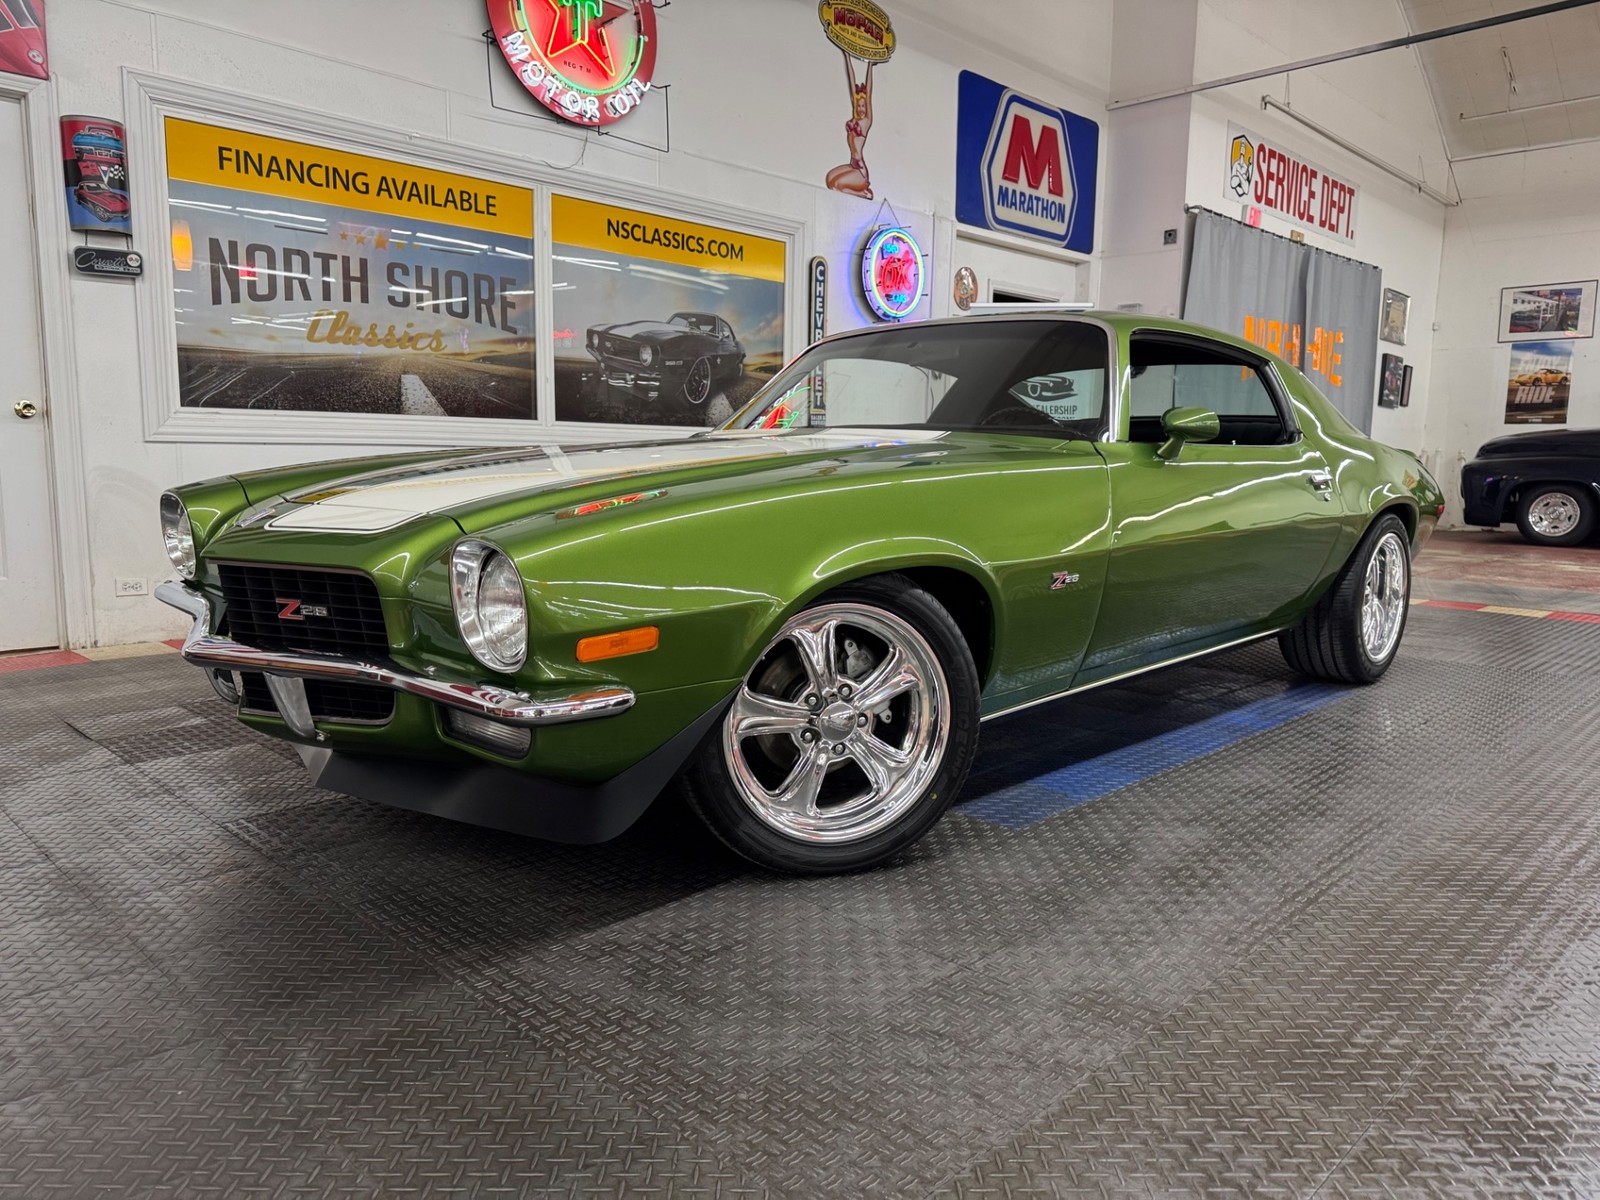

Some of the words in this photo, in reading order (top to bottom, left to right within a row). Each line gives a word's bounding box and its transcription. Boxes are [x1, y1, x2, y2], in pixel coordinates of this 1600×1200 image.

[834, 7, 884, 46] MOPAR
[503, 31, 600, 120] MOTOR
[605, 78, 650, 117] OIL
[217, 145, 370, 195] FINANCING
[376, 175, 498, 217] AVAILABLE
[1002, 114, 1063, 198] M
[997, 185, 1066, 224] MARATHON
[1254, 143, 1318, 224] SERVICE
[1319, 174, 1356, 240] DEPT.
[607, 218, 744, 262] NSCLASSICS.COM
[208, 237, 370, 306] NORTH
[386, 260, 518, 335] SHORE
[306, 308, 448, 353] Classics
[815, 265, 825, 406] CHEVRLET
[1034, 405, 1078, 415] EALERSHIP
[1514, 385, 1556, 404] RIDE
